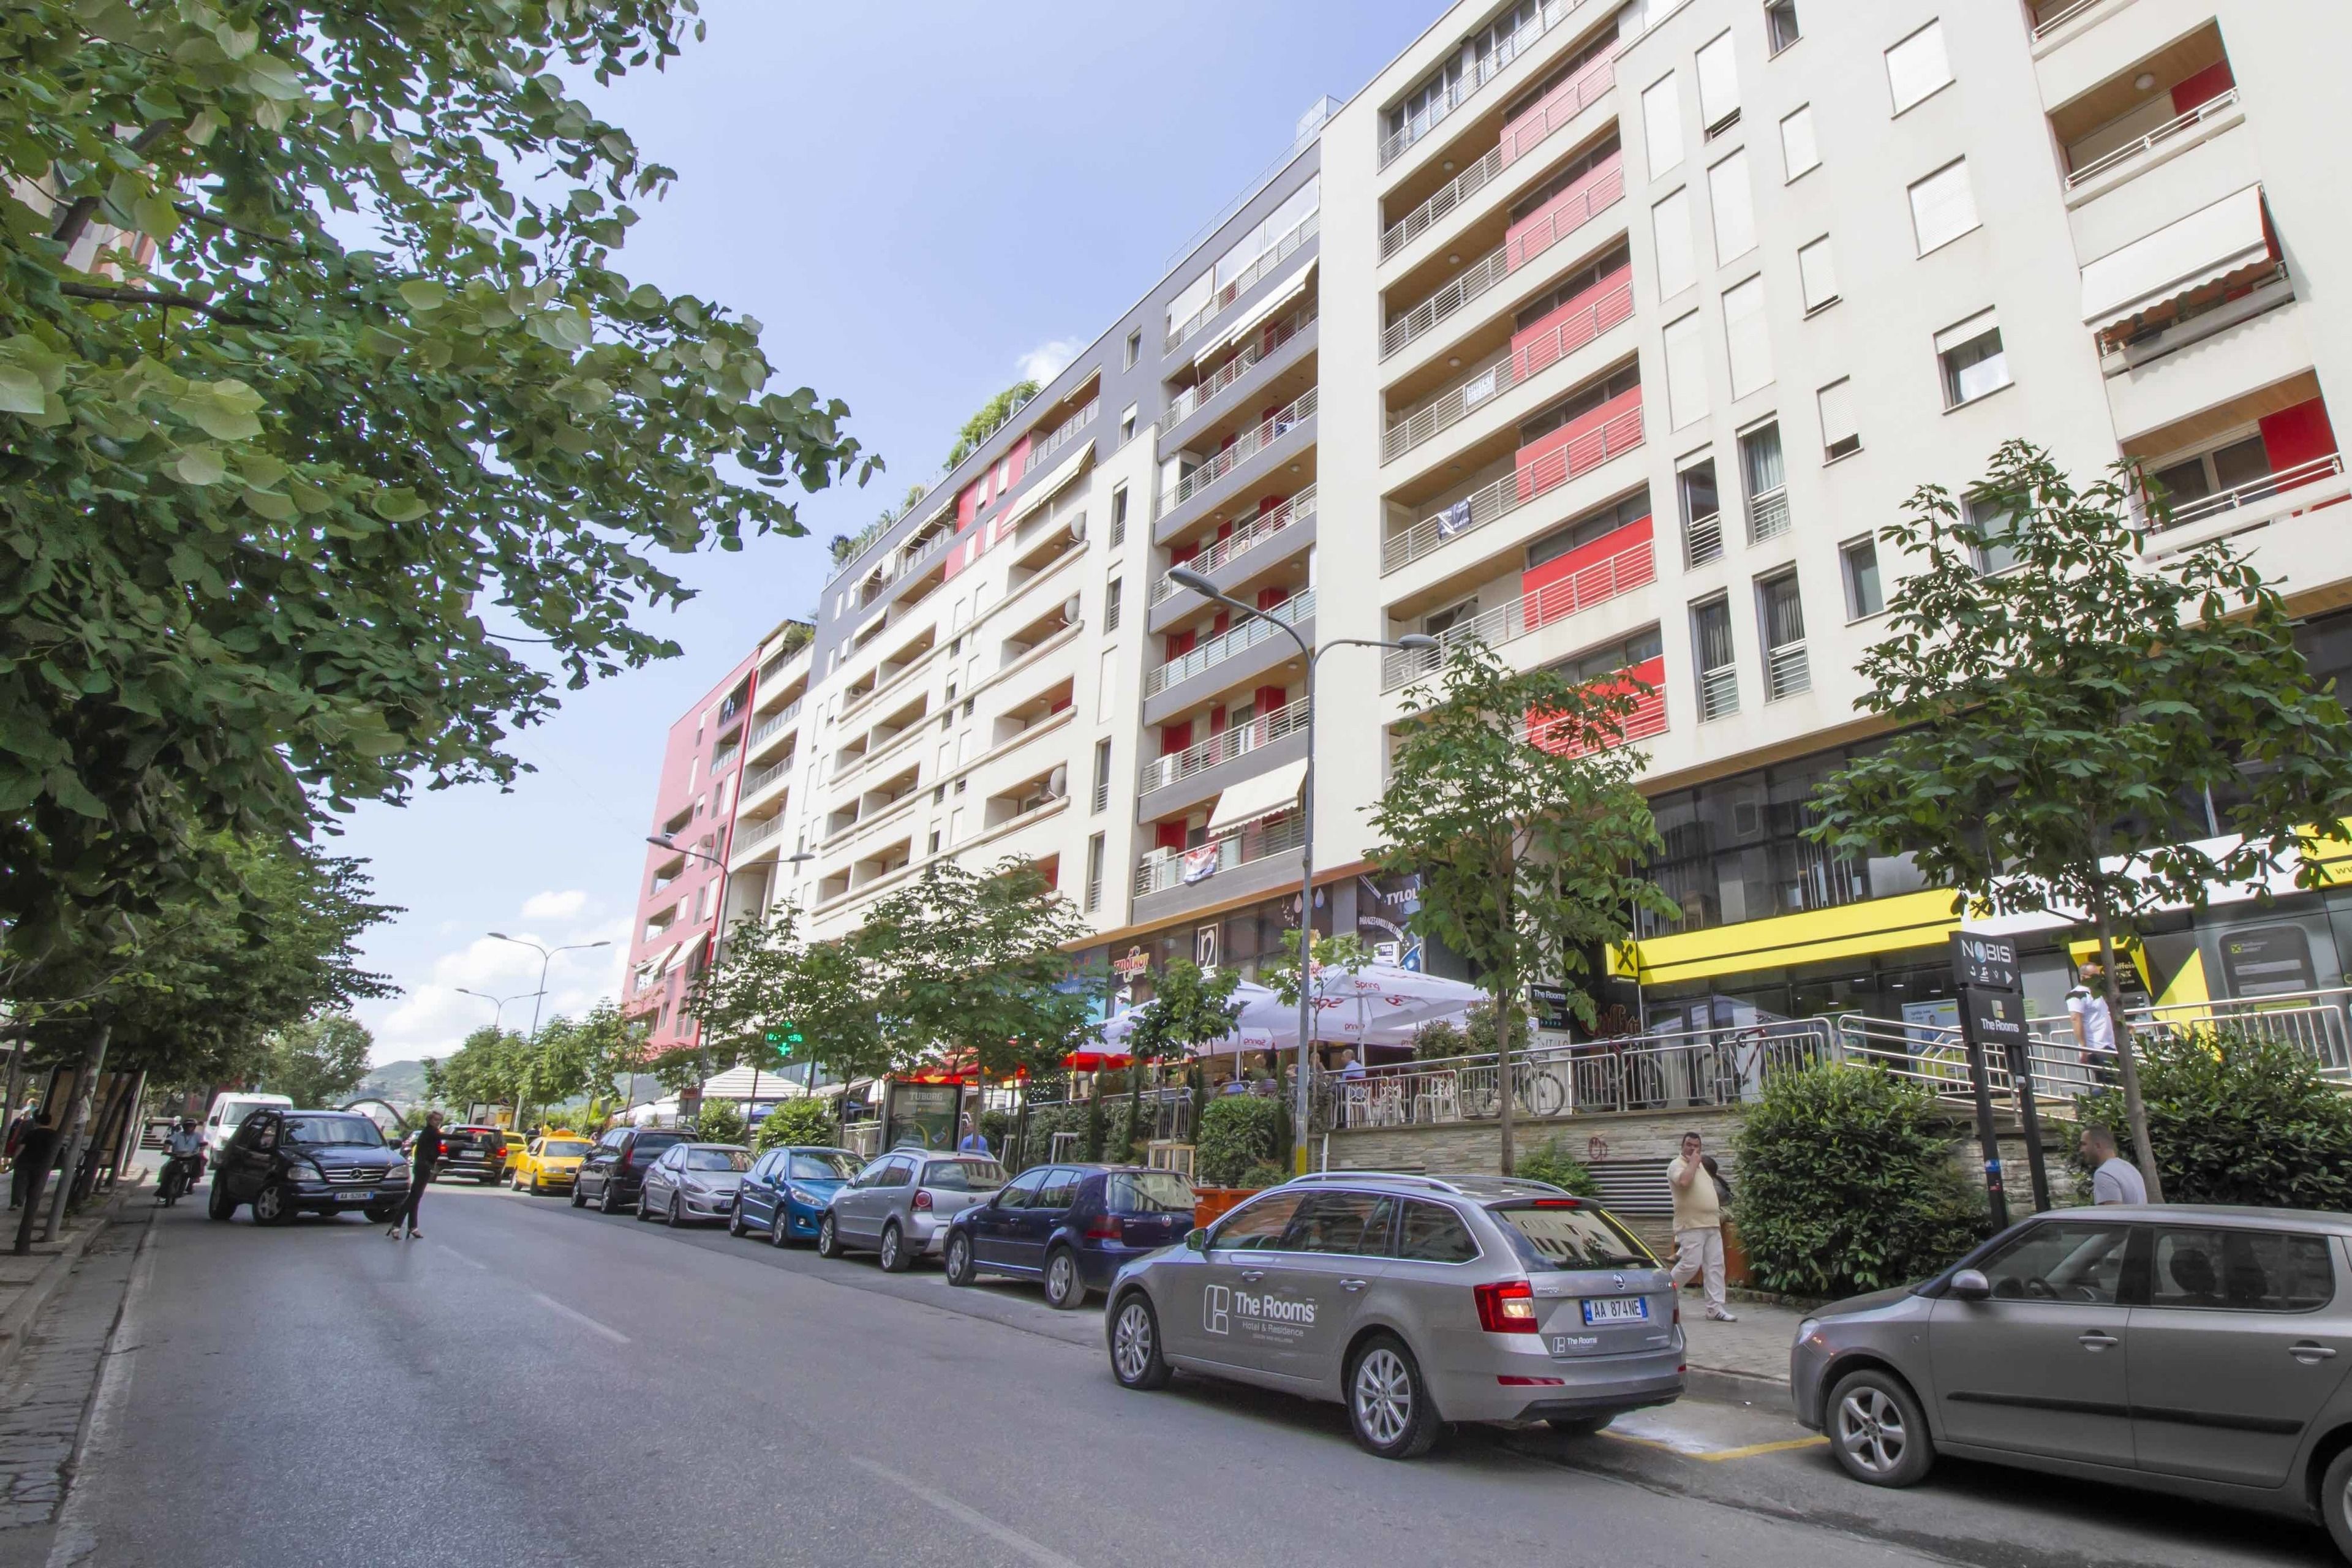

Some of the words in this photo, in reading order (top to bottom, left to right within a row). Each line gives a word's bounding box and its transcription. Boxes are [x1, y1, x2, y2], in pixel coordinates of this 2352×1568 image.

[1386, 888, 1417, 905] TYLOL
[1961, 940, 2011, 963] NOBIS
[1355, 981, 1380, 991] Spring
[1533, 989, 1545, 998] The
[1546, 990, 1566, 1000] Rooms
[1980, 1018, 1995, 1030] The
[1996, 1019, 2019, 1033] Rooms
[909, 1091, 943, 1101] TUBORG
[1235, 1292, 1261, 1316] The
[1263, 1295, 1314, 1322] Rooms
[1594, 1302, 1607, 1318] AA
[1242, 1321, 1260, 1332] Hotel
[1261, 1323, 1268, 1332] &
[1268, 1324, 1304, 1337] Residence
